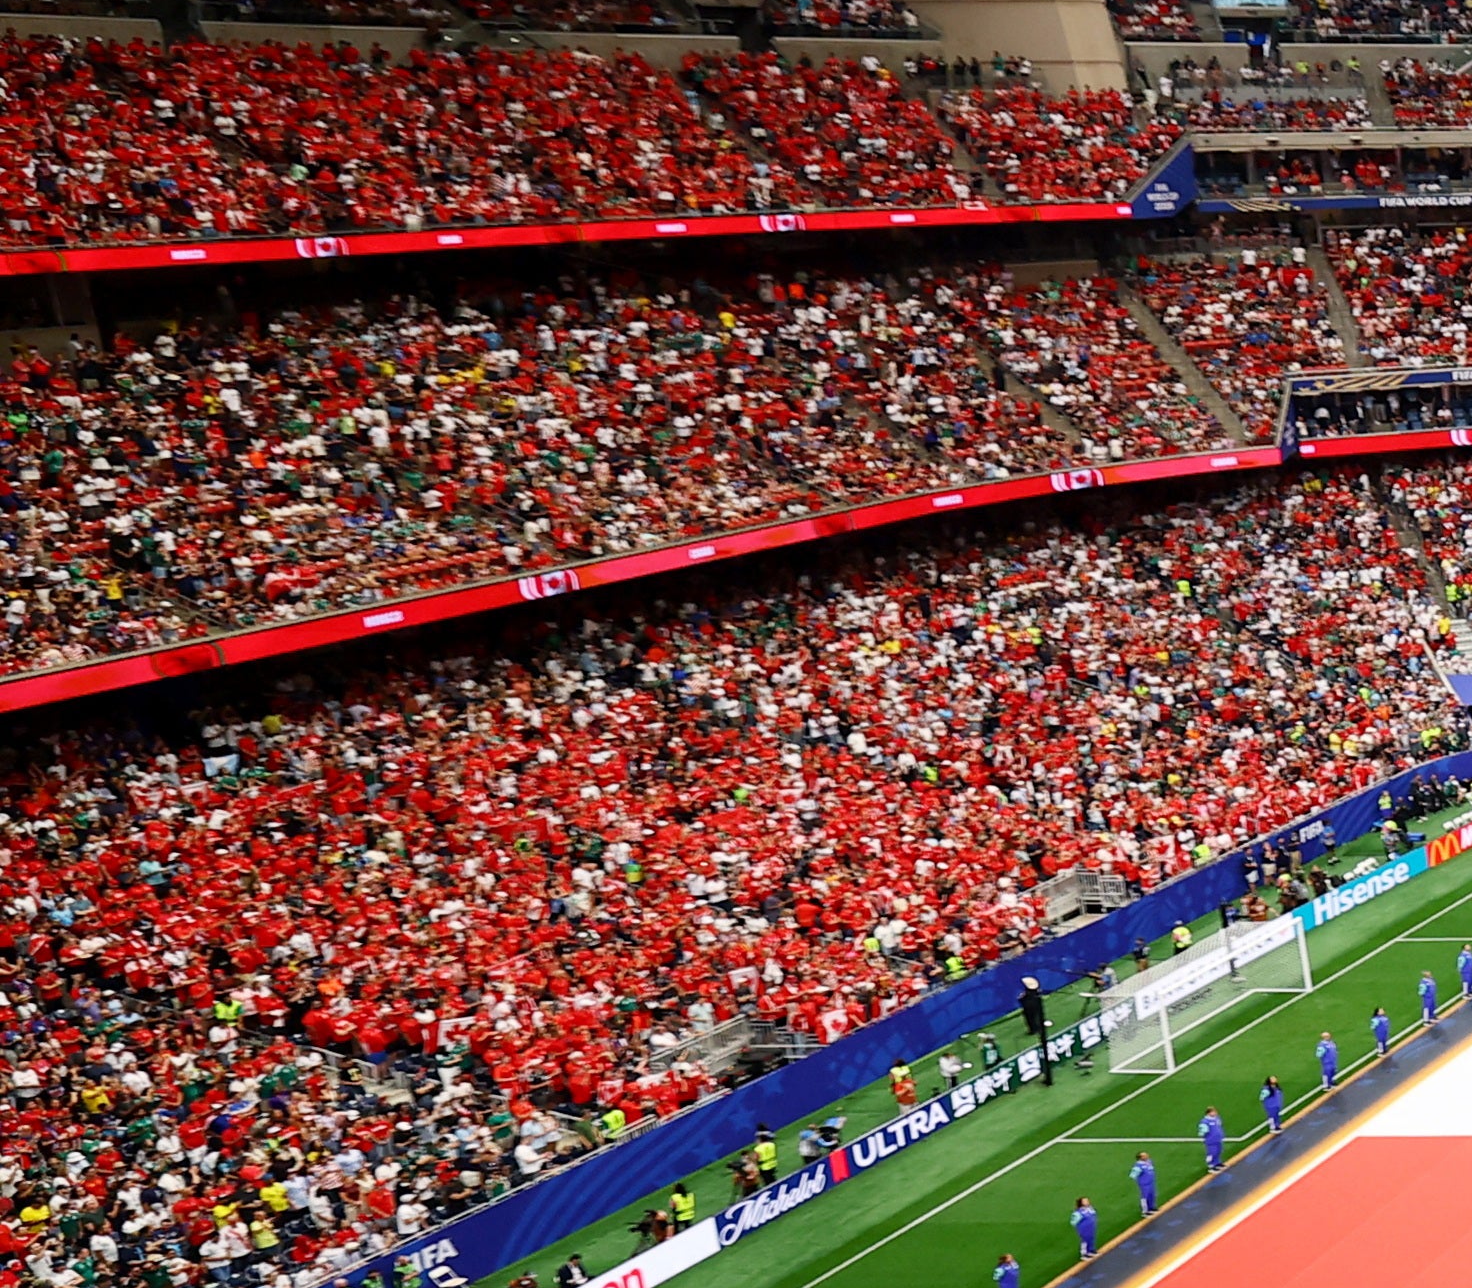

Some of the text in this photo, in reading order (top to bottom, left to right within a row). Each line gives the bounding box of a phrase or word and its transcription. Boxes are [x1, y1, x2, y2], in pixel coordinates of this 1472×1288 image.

[1379, 197, 1406, 207] FIFA
[1407, 197, 1449, 207] WORLD
[1450, 196, 1471, 206] CUP
[1299, 819, 1324, 842] FIFA
[1313, 860, 1411, 924] Hisense
[720, 1101, 950, 1245] Michelob ULTRA
[409, 1237, 459, 1273] IFA
